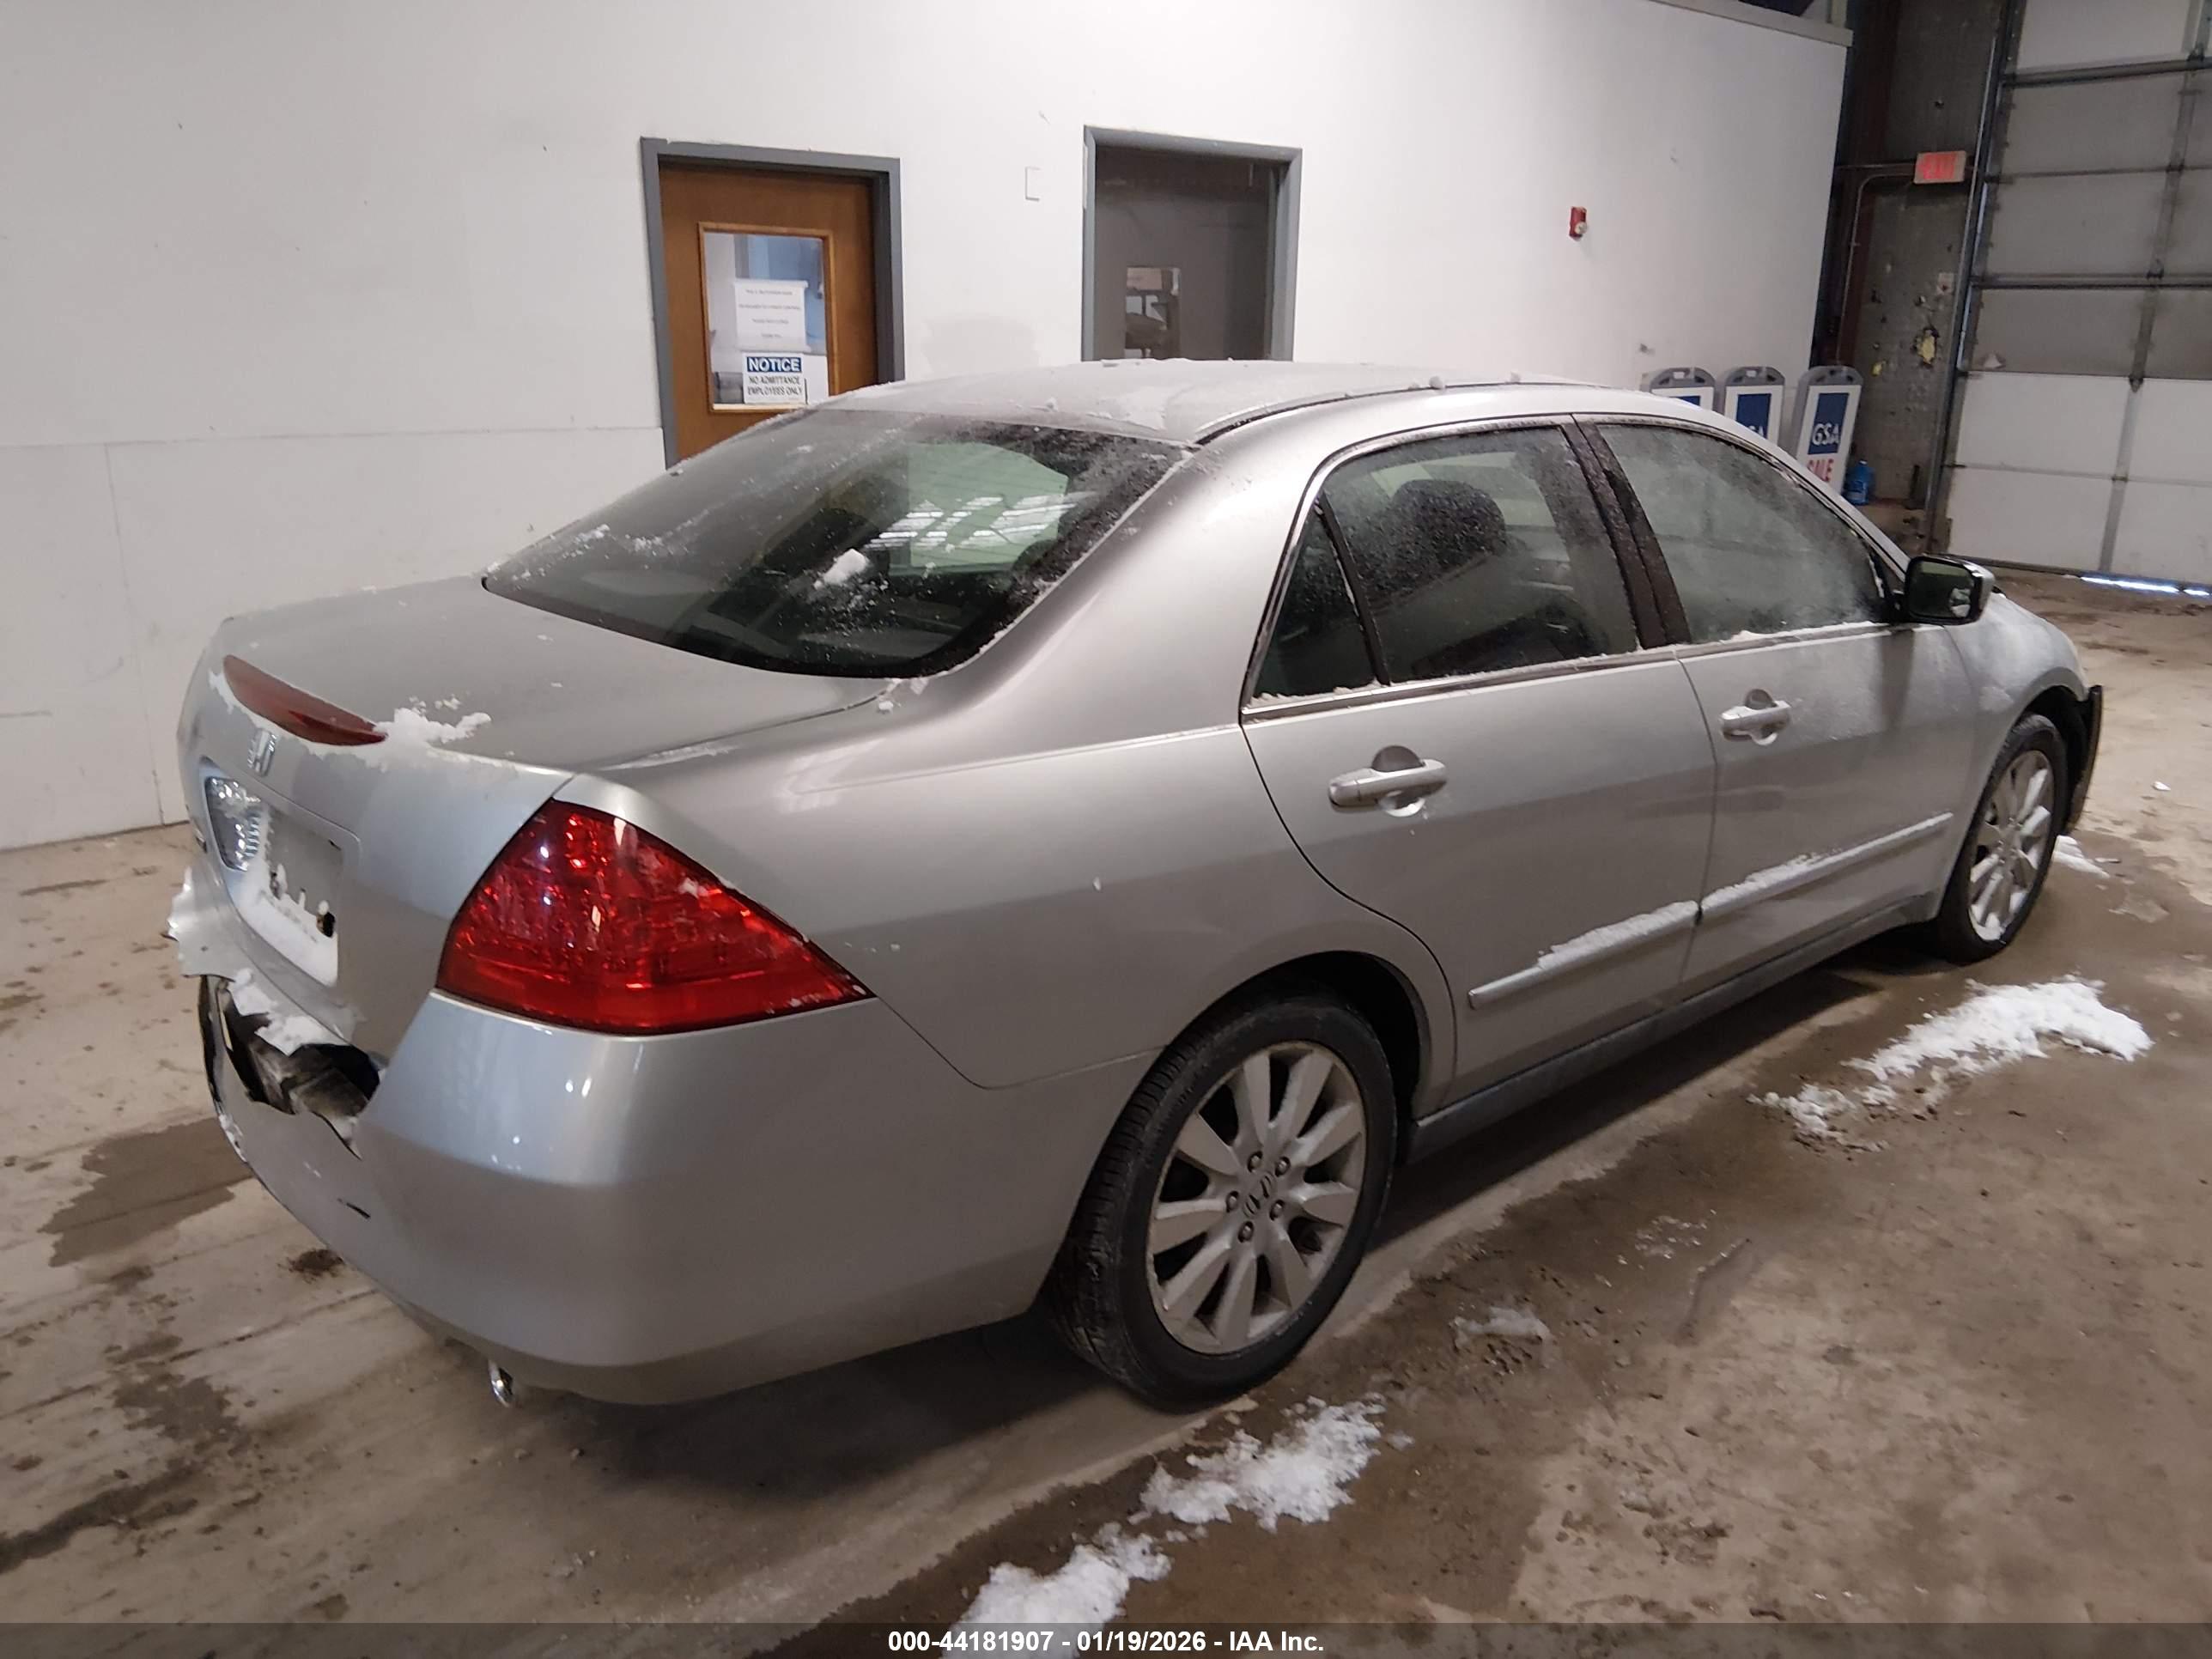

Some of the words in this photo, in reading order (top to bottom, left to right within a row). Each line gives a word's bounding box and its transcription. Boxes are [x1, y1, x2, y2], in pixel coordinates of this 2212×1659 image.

[749, 358, 800, 371] NOTICE
[749, 375, 759, 385] NO
[762, 376, 799, 386] ADMITTANCE
[747, 386, 785, 396] EMPLOYEES
[786, 386, 802, 396] ONLY
[1812, 422, 1839, 446] GSA
